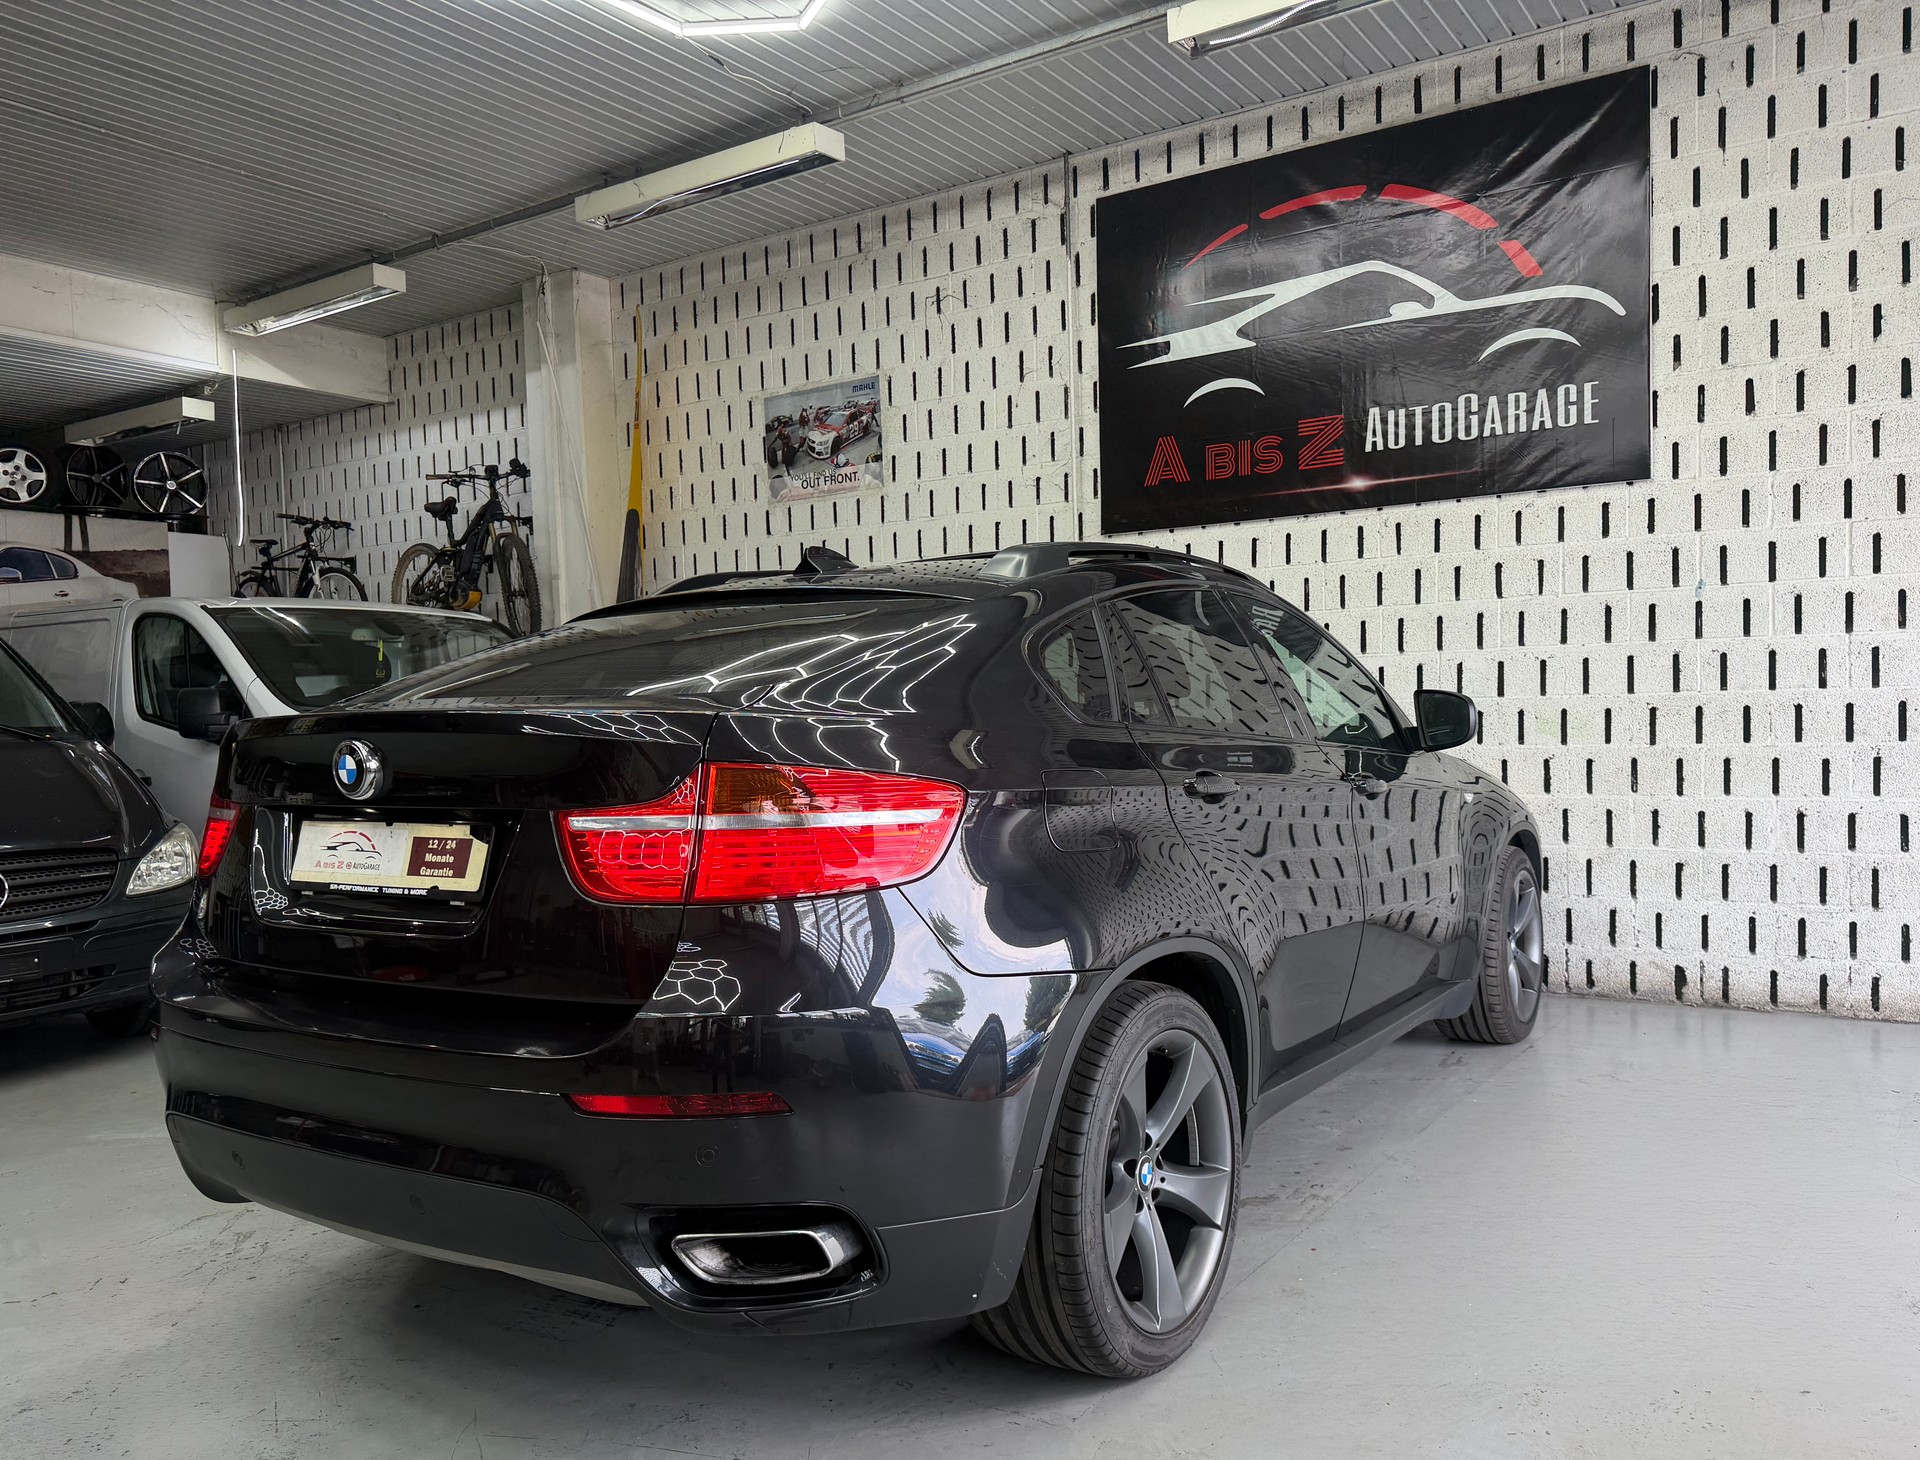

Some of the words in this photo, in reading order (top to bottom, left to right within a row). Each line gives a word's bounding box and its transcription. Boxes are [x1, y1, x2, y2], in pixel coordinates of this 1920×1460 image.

[852, 382, 875, 393] MAHLE
[1144, 435, 1190, 487] A
[1205, 435, 1284, 481] BIS
[1298, 414, 1345, 471] Z
[801, 477, 821, 489] OUT
[824, 471, 860, 486] FRONT.
[427, 839, 438, 849] 12
[445, 840, 457, 849] 24
[424, 853, 455, 863] Monate
[314, 860, 322, 868] A
[336, 861, 345, 869] Z
[420, 866, 454, 877] Garantie
[382, 887, 403, 895] TUNING
